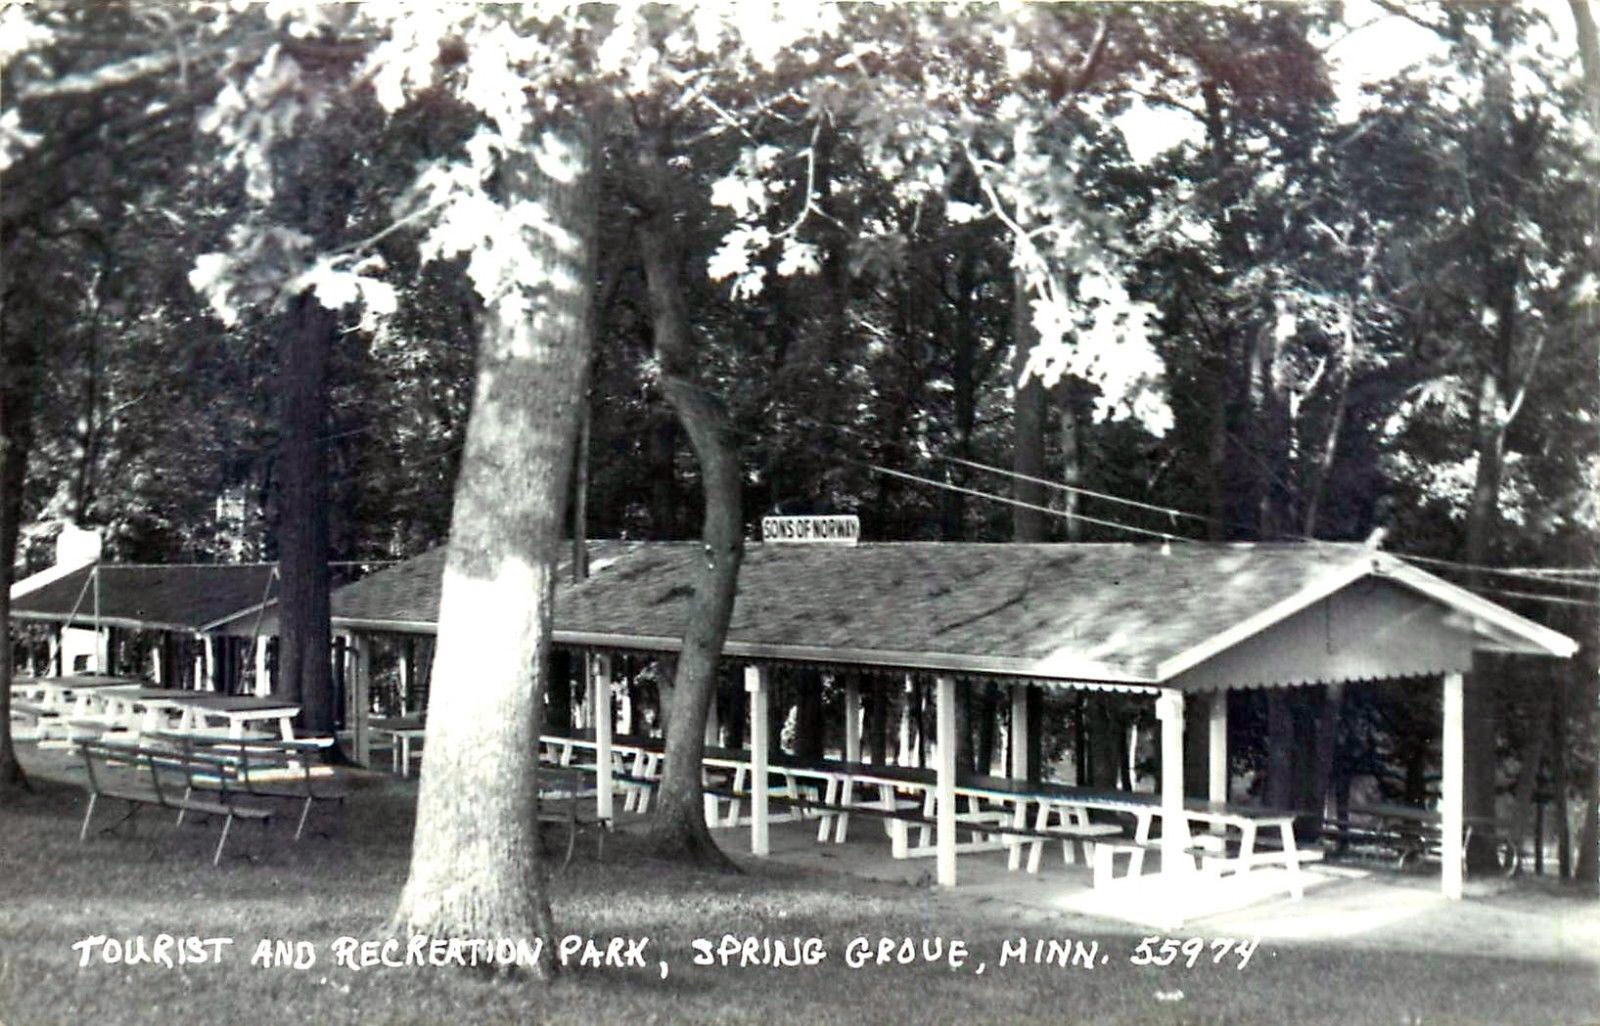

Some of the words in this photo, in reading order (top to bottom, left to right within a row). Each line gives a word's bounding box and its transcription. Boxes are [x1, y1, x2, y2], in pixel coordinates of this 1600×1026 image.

[764, 519, 794, 538] SONS
[796, 519, 811, 538] OF
[812, 518, 858, 538] NORWAY
